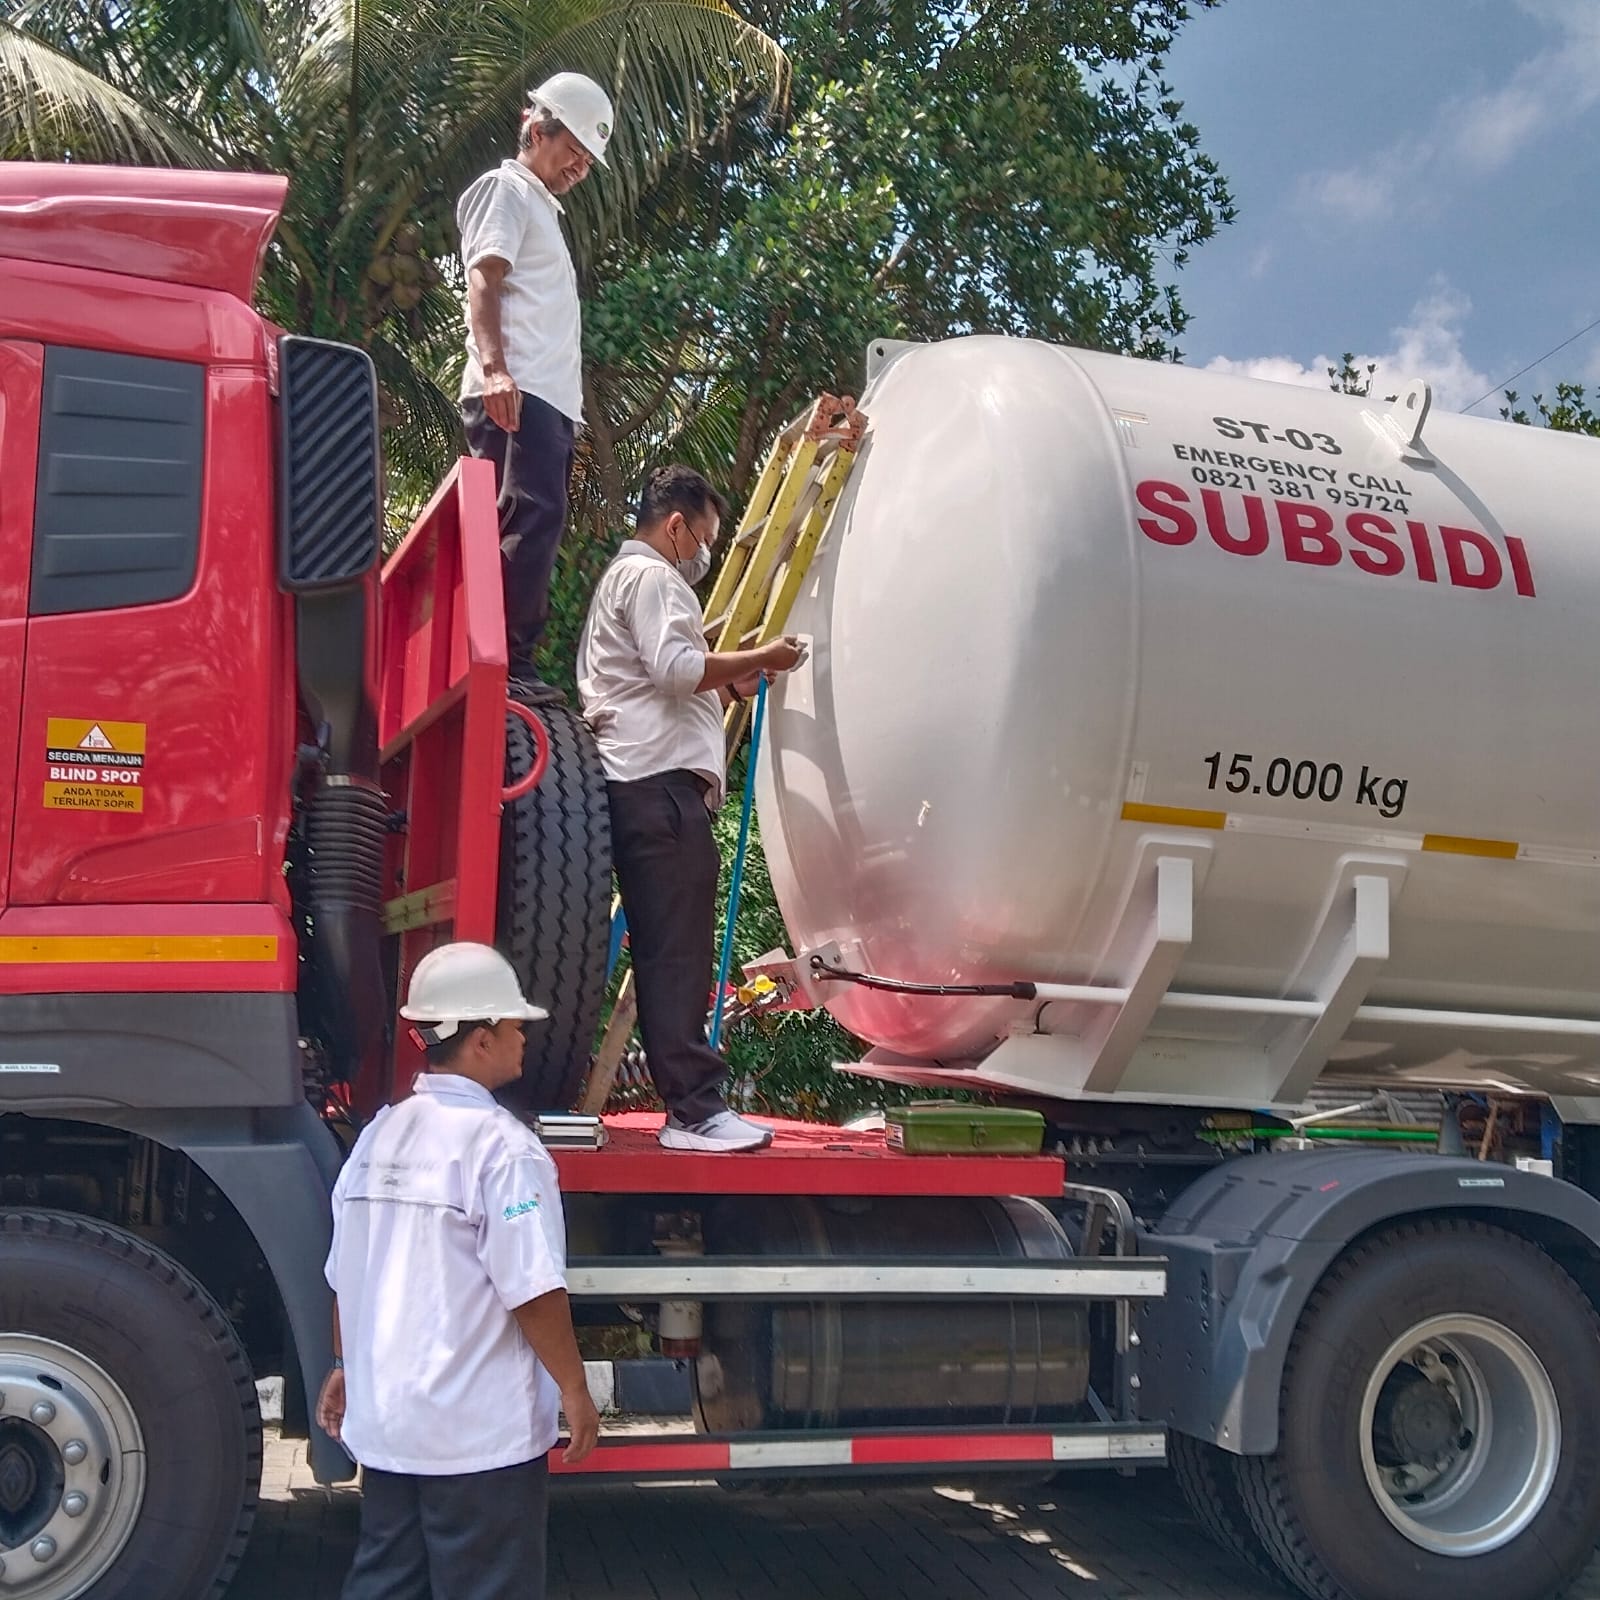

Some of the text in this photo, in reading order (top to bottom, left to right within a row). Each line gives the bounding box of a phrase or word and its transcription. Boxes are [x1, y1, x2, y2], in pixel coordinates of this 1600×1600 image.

[1212, 416, 1343, 455] ST-03
[1173, 444, 1413, 496] EMERGENCY CALL
[1191, 466, 1409, 514] 0821 381 95724
[1135, 480, 1537, 598] SUBSIDI
[48, 751, 91, 762] SEGERA
[50, 767, 140, 783] BLIND SPOT
[53, 797, 134, 809] TERLIHAT SOPIR
[63, 787, 125, 798] ANDA TIDAK
[1204, 752, 1409, 818] 15.000 kg
